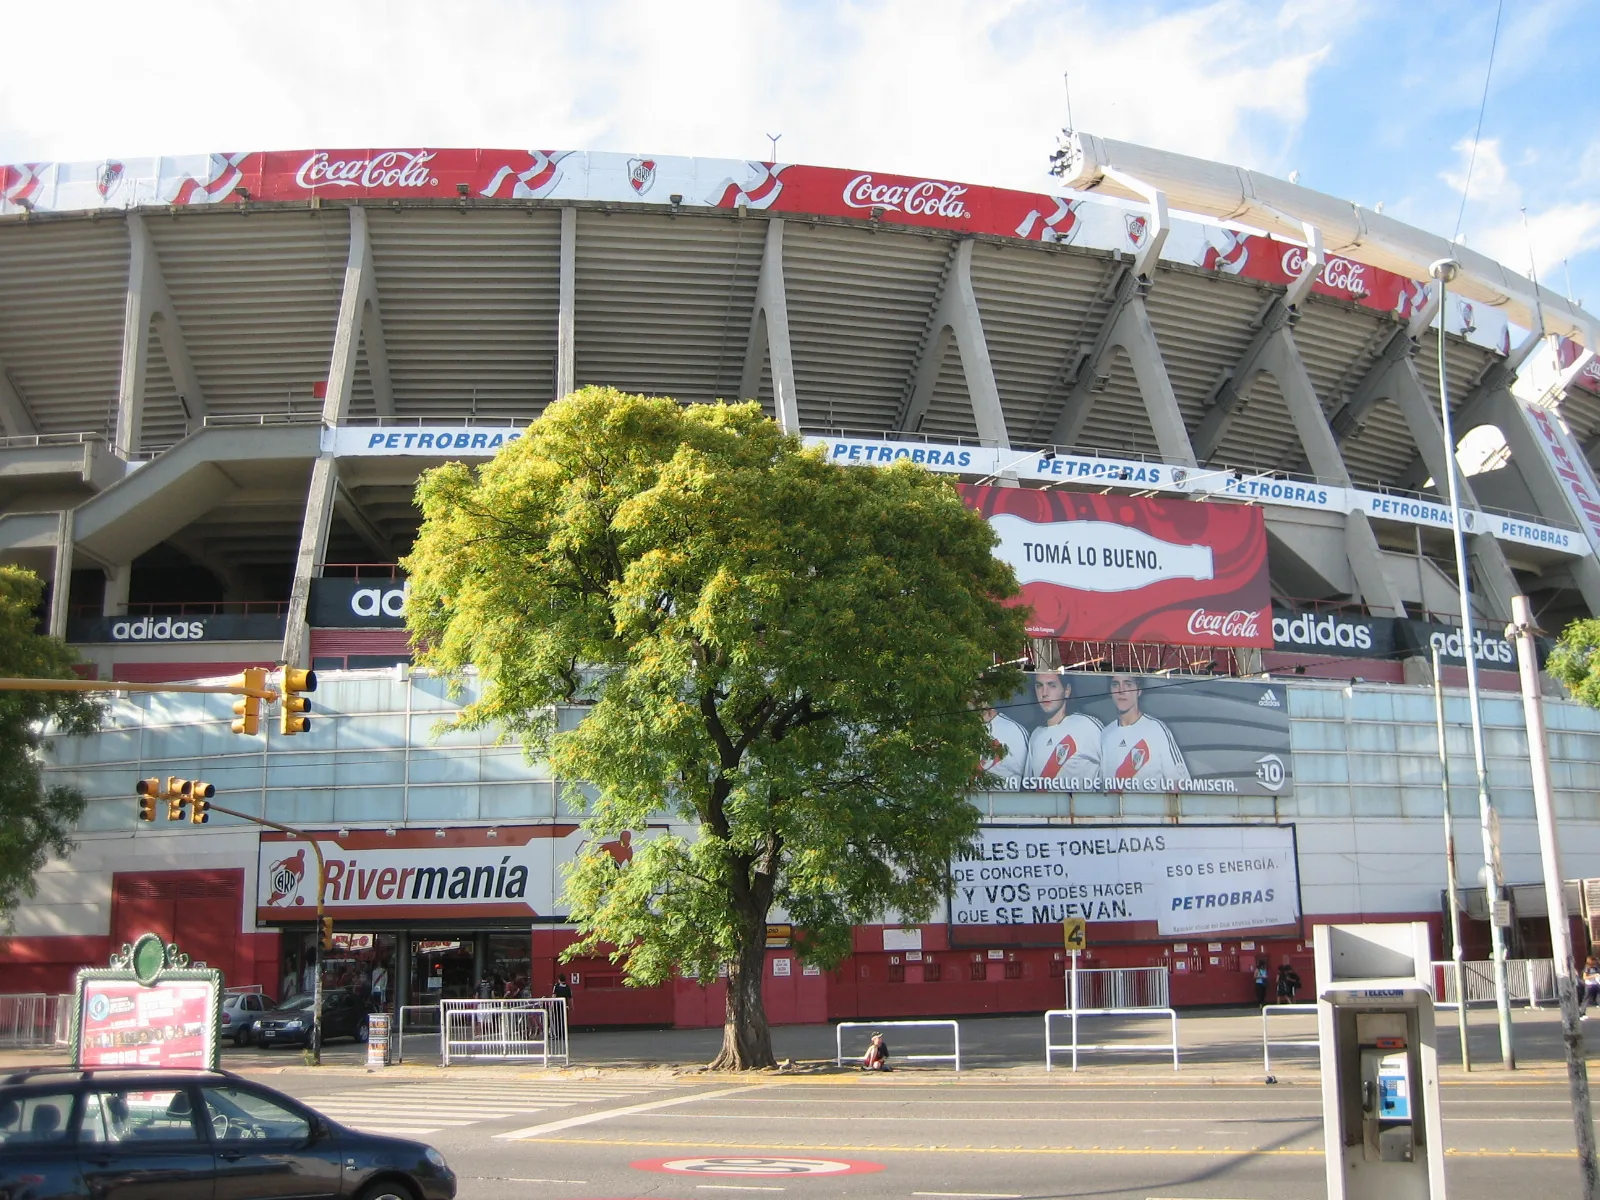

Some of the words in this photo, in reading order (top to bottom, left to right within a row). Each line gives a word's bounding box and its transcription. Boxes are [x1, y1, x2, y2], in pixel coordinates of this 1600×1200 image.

[296, 151, 437, 189] Coca-Cola
[843, 175, 968, 218] Coca-Cola
[833, 444, 970, 466] PETROBRAS
[1037, 459, 1160, 482] PETROBRAS
[1225, 478, 1327, 504] PETROBRAS
[1502, 522, 1568, 547] PETROBRAS
[1023, 541, 1071, 565] TOMÁ
[1078, 546, 1096, 566] LO
[1103, 548, 1162, 570] BUENO.
[113, 617, 204, 639] adidas
[1187, 608, 1260, 637] Coca-Cola
[1272, 613, 1371, 649] adidas
[1430, 628, 1511, 664] addas
[1022, 776, 1079, 790] ESTRELLA
[1083, 777, 1100, 790] DE
[1105, 777, 1139, 790] RIVER
[1143, 778, 1156, 790] ES
[1160, 778, 1174, 791] LA
[1178, 779, 1238, 792] CAMISETA.
[1256, 764, 1280, 782] +10
[958, 841, 1018, 862] MILES
[1026, 843, 1050, 859] DE
[1057, 836, 1165, 856] TONELADAS
[323, 856, 529, 901] Rivermanía
[954, 869, 974, 881] DE
[980, 864, 1068, 880] CONCRETO,
[1166, 864, 1193, 877] ESO
[1198, 862, 1214, 875] ES
[962, 887, 975, 904] Y
[984, 883, 1031, 904] VOS
[1093, 882, 1143, 898] HACER
[1171, 889, 1275, 911] PETROBRAS
[957, 909, 989, 924] QUE
[996, 907, 1023, 924] SE
[1032, 898, 1132, 924] MUEVAN.
[1068, 925, 1083, 946] 4
[891, 956, 900, 964] 10
[926, 955, 932, 963] 9
[976, 954, 981, 962] 8
[1009, 953, 1014, 961] 7
[1086, 951, 1092, 959] 5
[1164, 948, 1169, 957] 4
[1365, 989, 1404, 997] TELECOM
